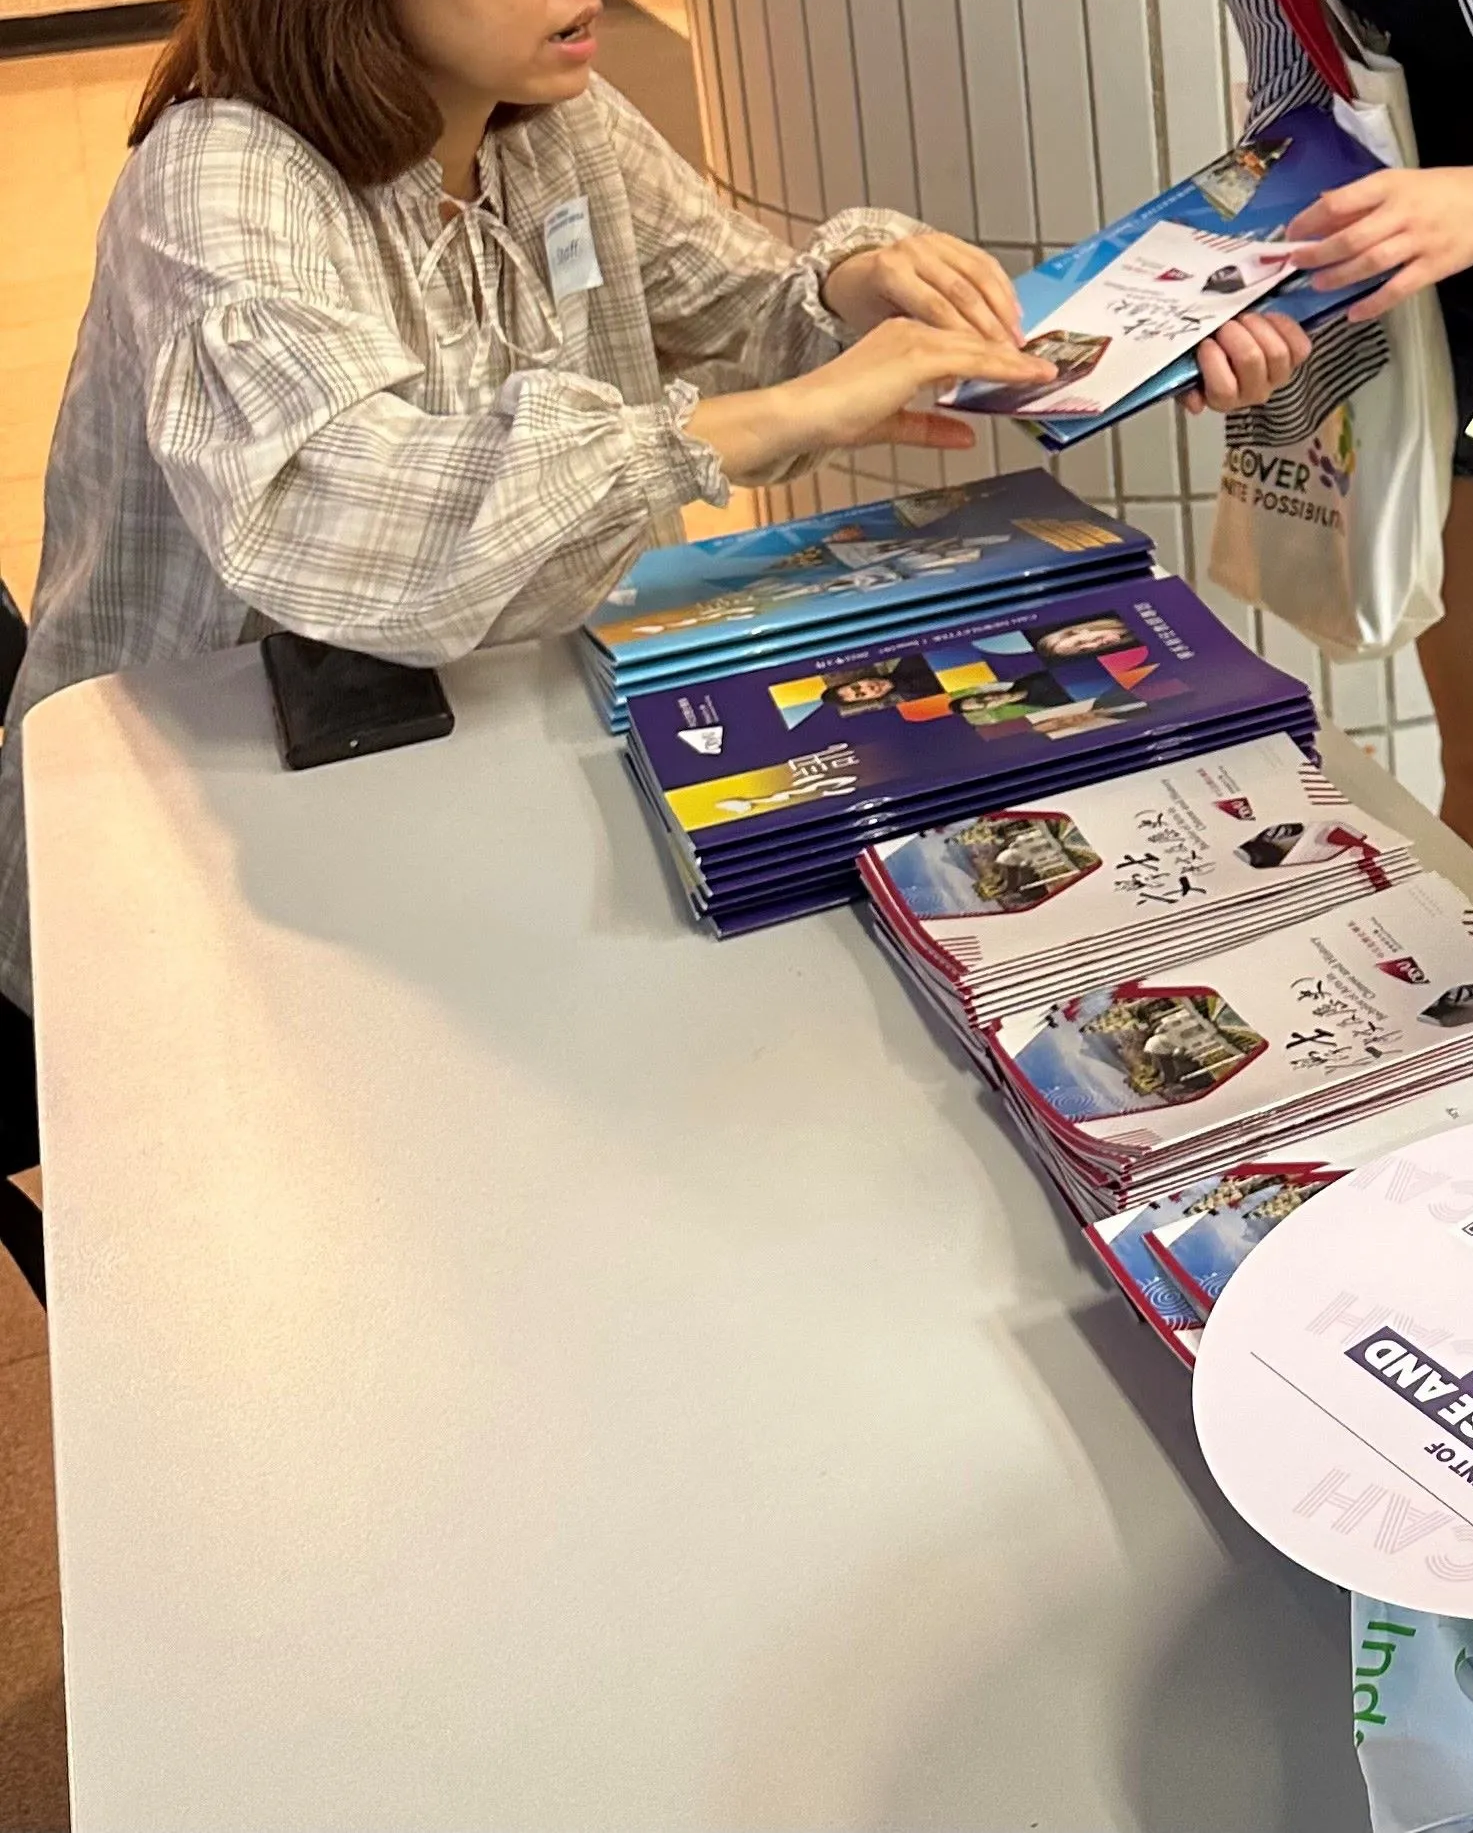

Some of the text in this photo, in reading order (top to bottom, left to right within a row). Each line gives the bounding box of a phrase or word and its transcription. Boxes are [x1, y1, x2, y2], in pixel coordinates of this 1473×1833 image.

[1364, 1339, 1460, 1404] AND
[1424, 1441, 1456, 1464] OF
[1354, 1620, 1417, 1749] Ind
